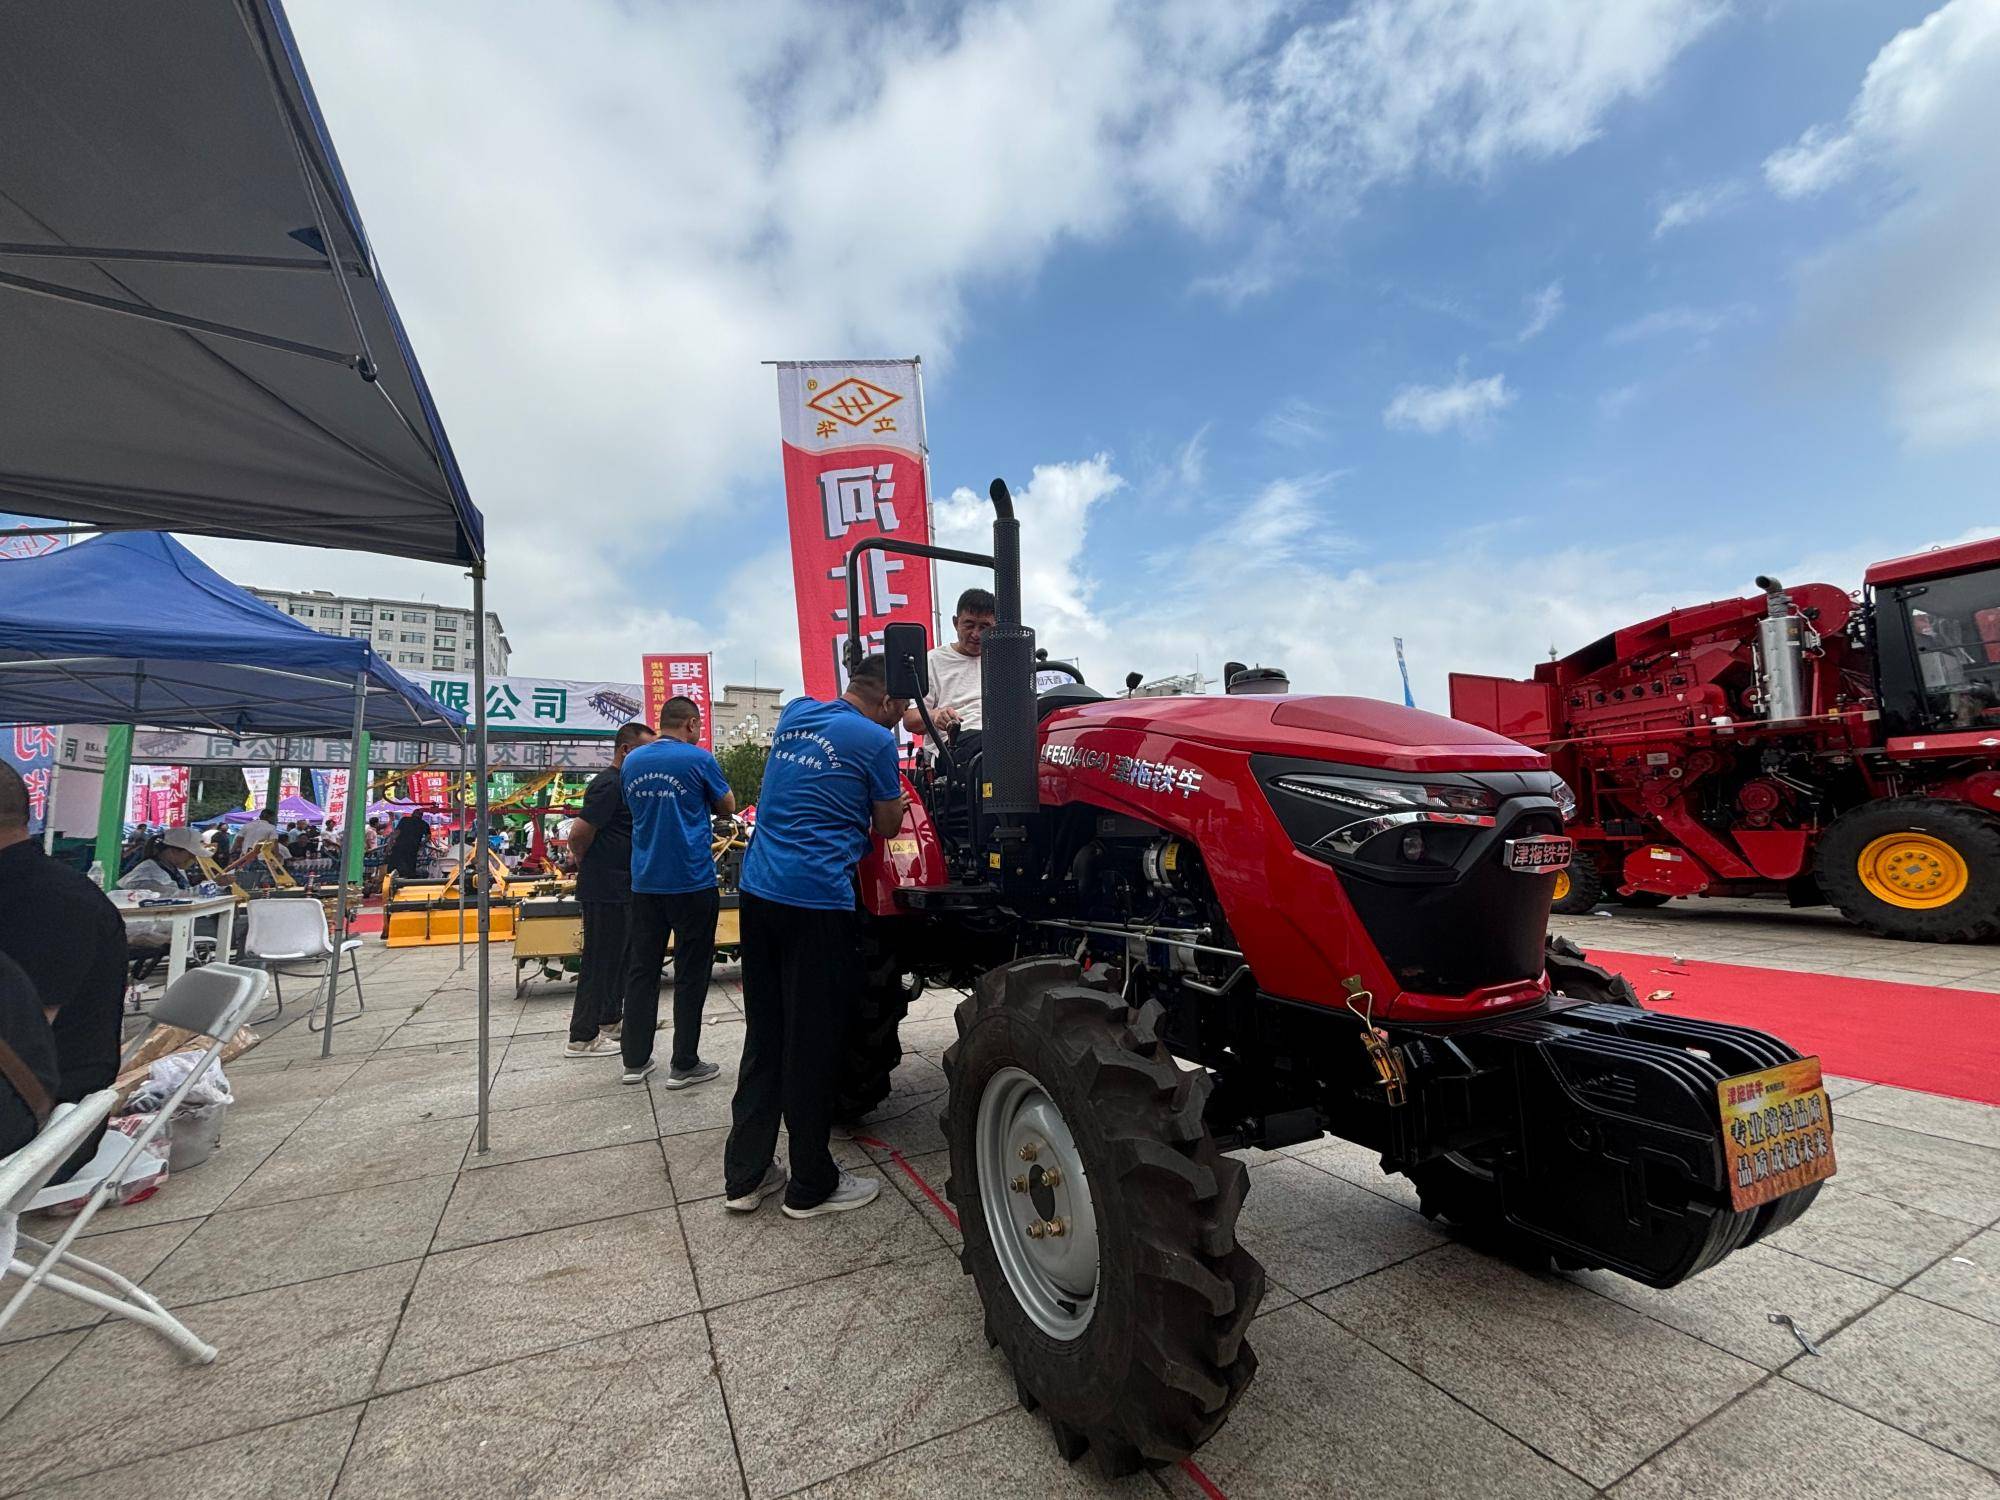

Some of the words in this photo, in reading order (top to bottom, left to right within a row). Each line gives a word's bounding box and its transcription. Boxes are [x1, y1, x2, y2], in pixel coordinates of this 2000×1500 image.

[430, 680, 567, 723] 限公司
[1736, 1127, 1830, 1188] 品质成就未来
